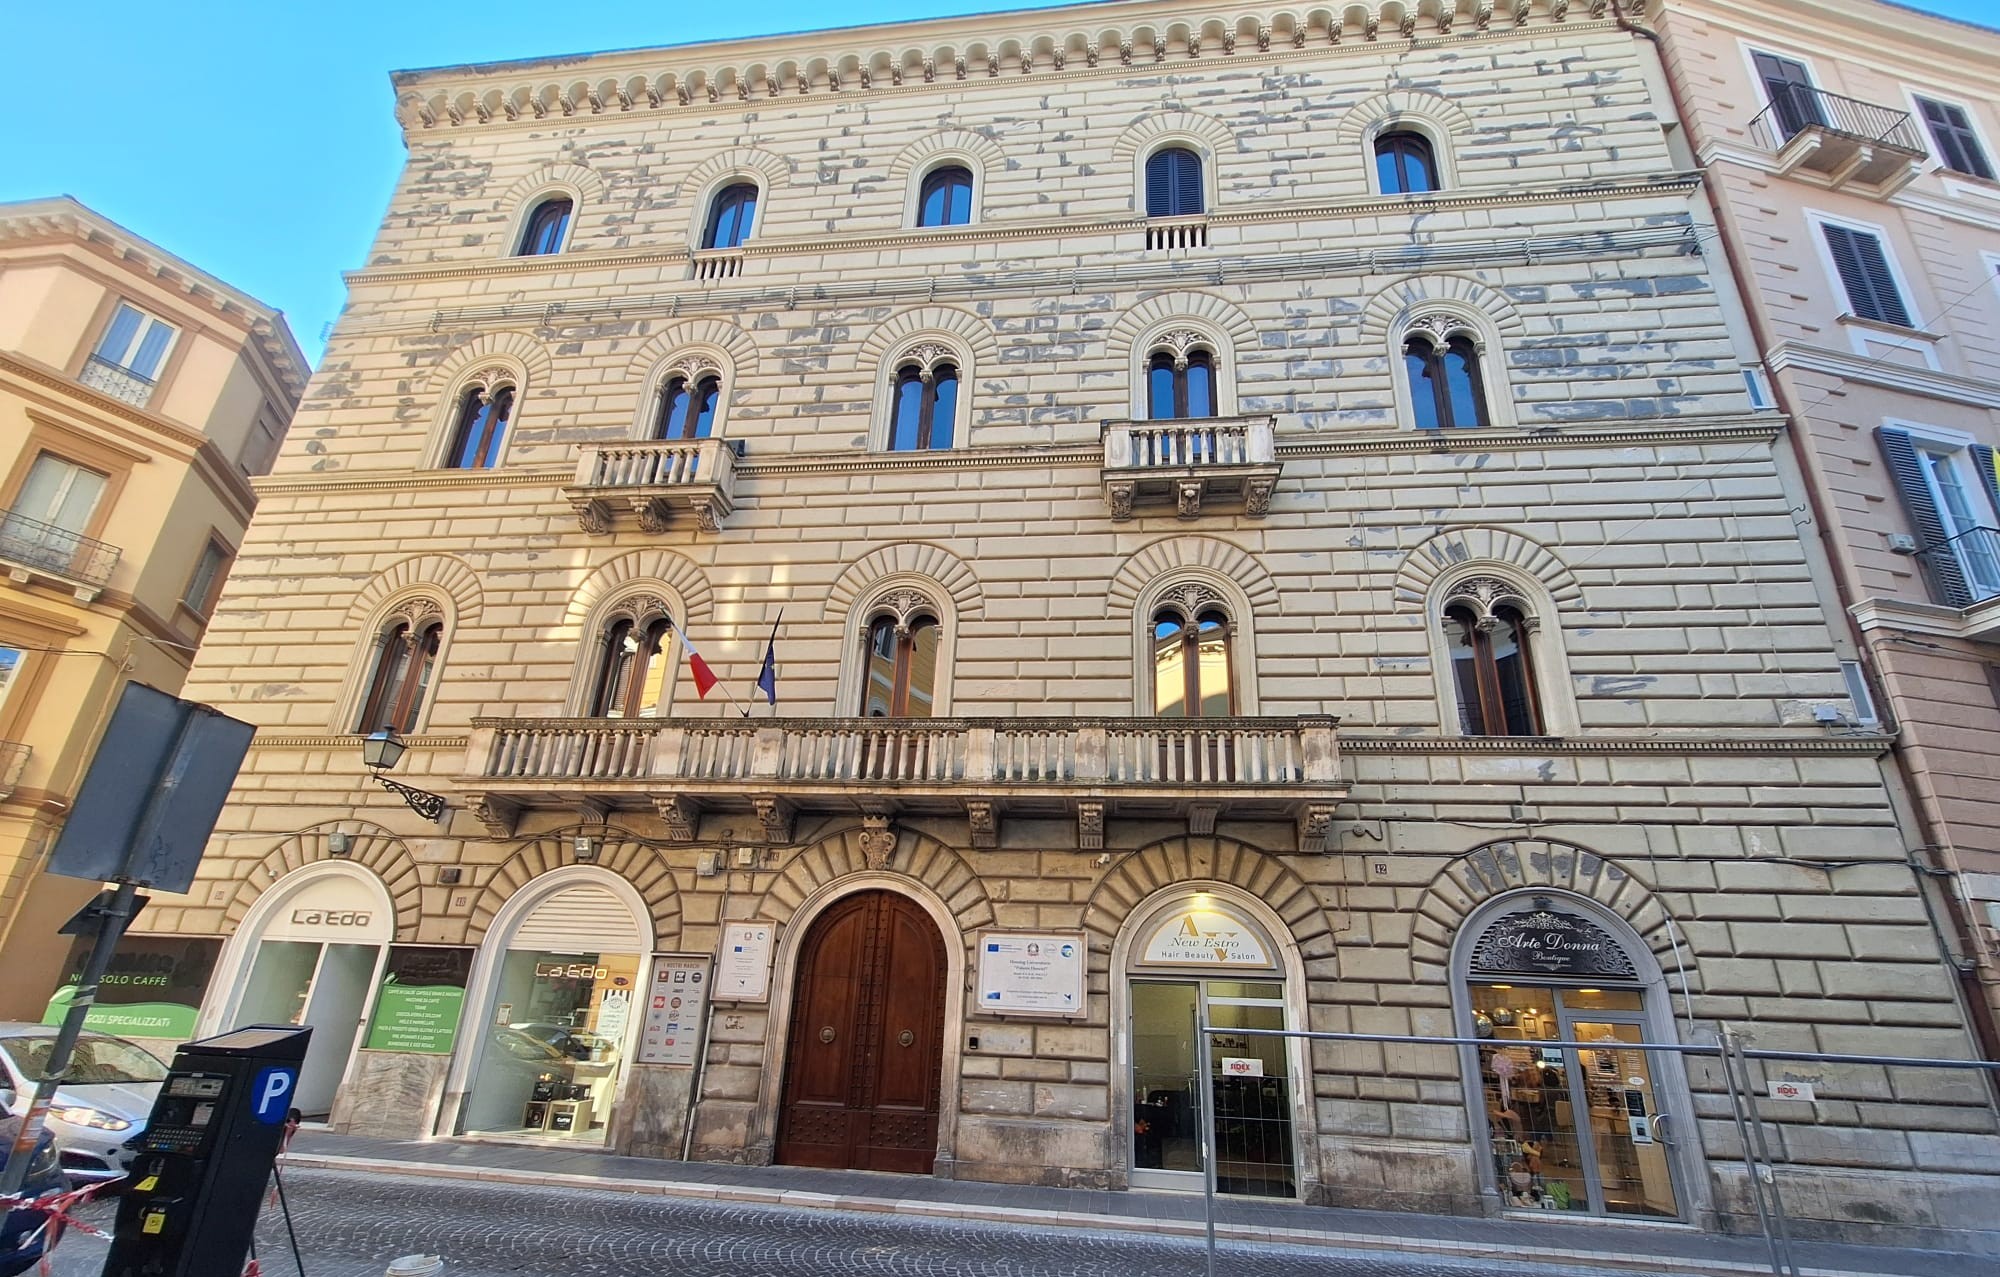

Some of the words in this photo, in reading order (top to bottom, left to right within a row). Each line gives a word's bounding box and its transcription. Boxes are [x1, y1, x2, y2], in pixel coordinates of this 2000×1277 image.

[1168, 937, 1200, 948] New
[1204, 937, 1241, 948] Estro
[1498, 932, 1541, 949] Arte
[1543, 932, 1600, 951] Donna
[1161, 951, 1180, 959] Hair
[1185, 951, 1214, 961] Beauty
[1231, 952, 1256, 960] Salon
[1532, 951, 1570, 964] Boutique
[99, 974, 129, 985] SOLO
[1230, 1063, 1250, 1071] SIDEX
[258, 1072, 290, 1114] P
